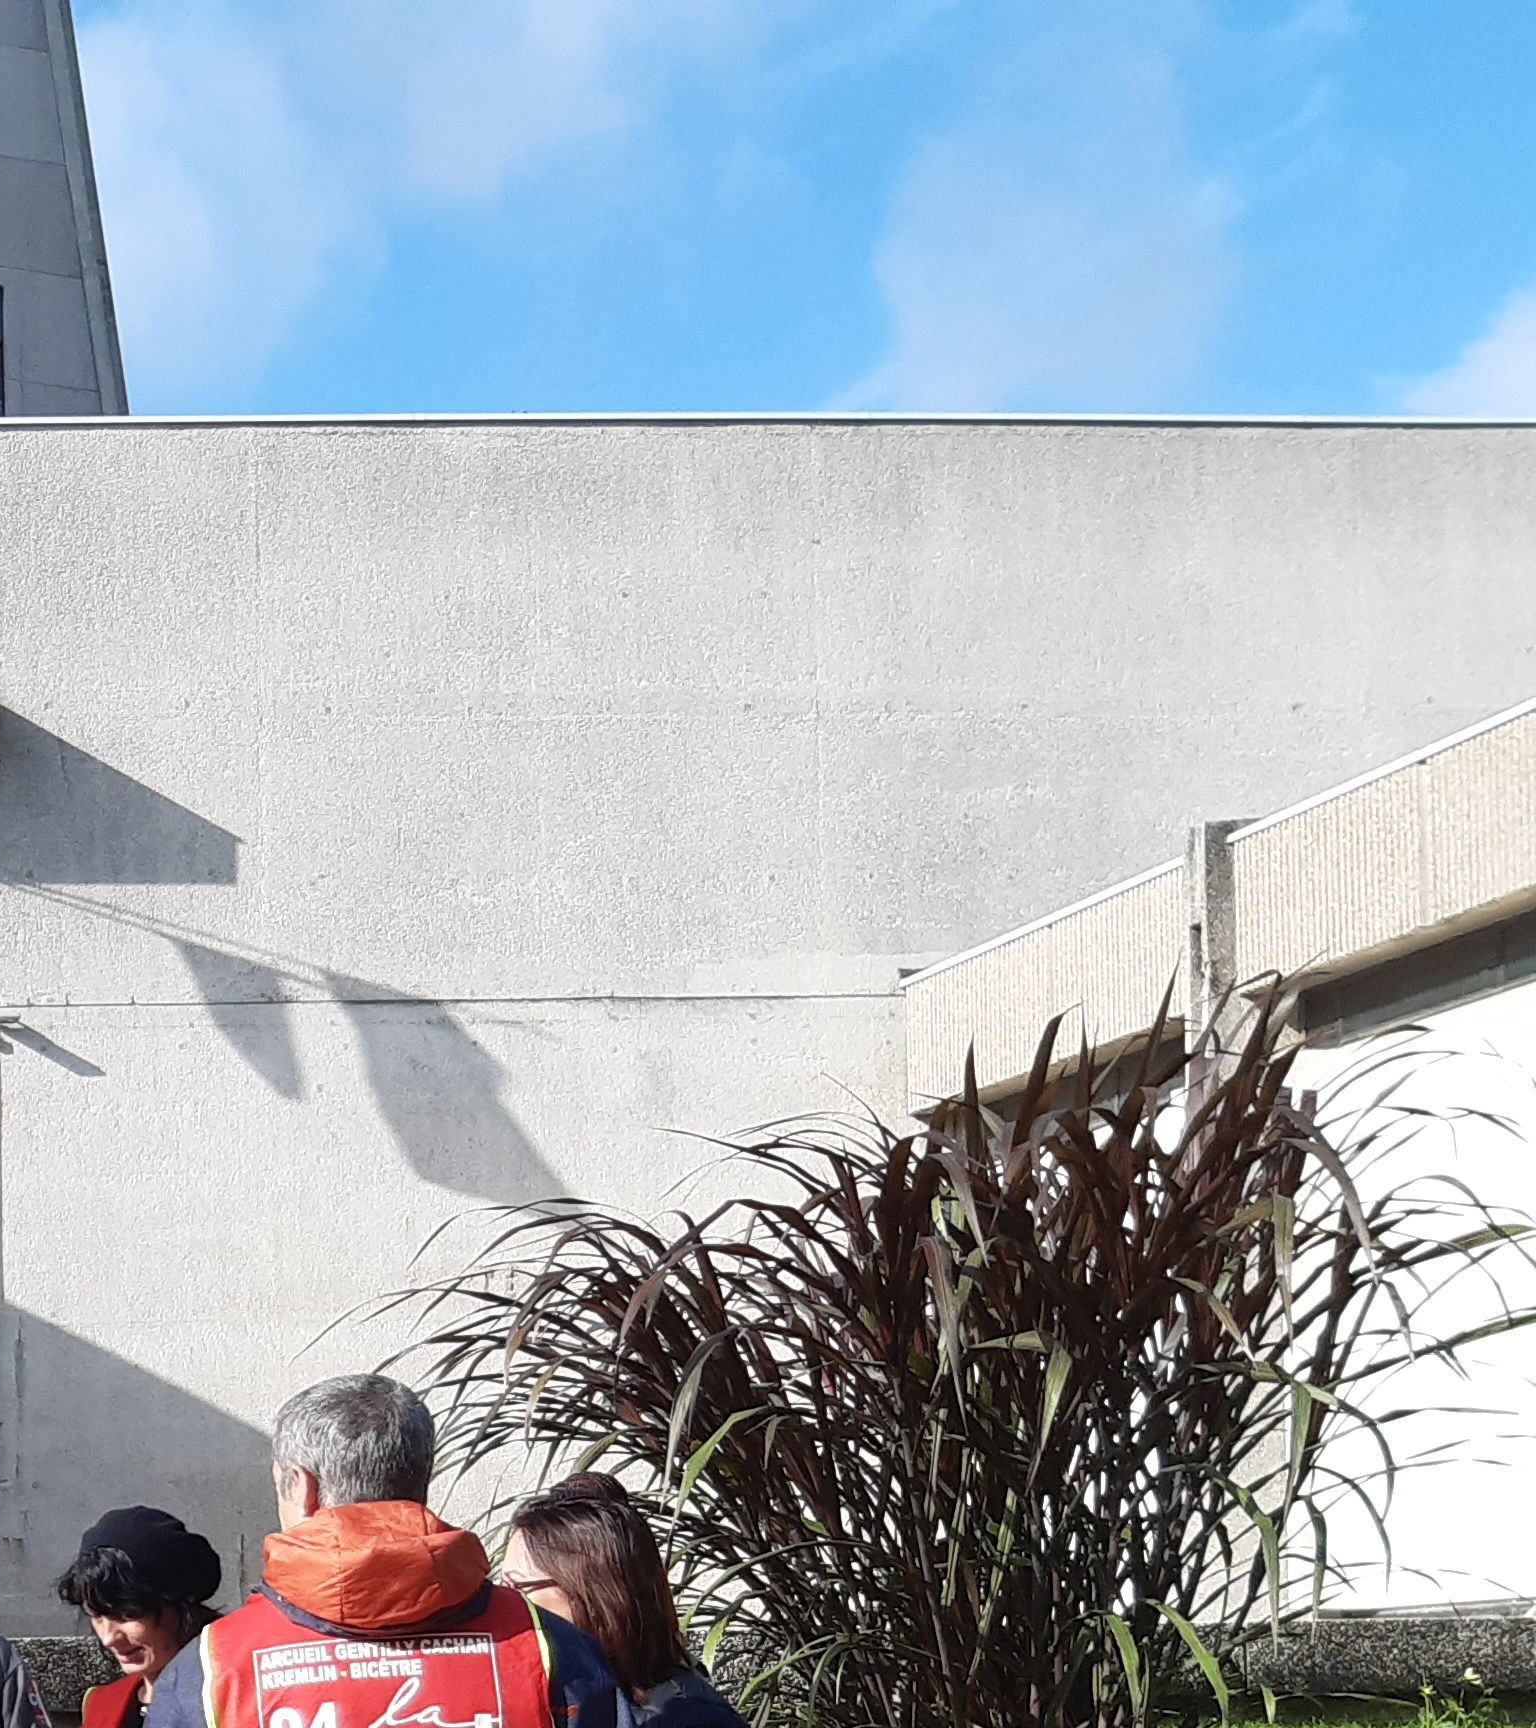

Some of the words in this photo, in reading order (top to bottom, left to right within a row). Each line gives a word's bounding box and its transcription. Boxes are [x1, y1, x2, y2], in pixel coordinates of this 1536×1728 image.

[260, 1646, 333, 1671] ARCUEIL
[335, 1640, 415, 1661] GENTILLY
[419, 1636, 490, 1655] CACHAN
[261, 1664, 338, 1690] KREMLIN
[350, 1658, 424, 1679] BICÊTRE
